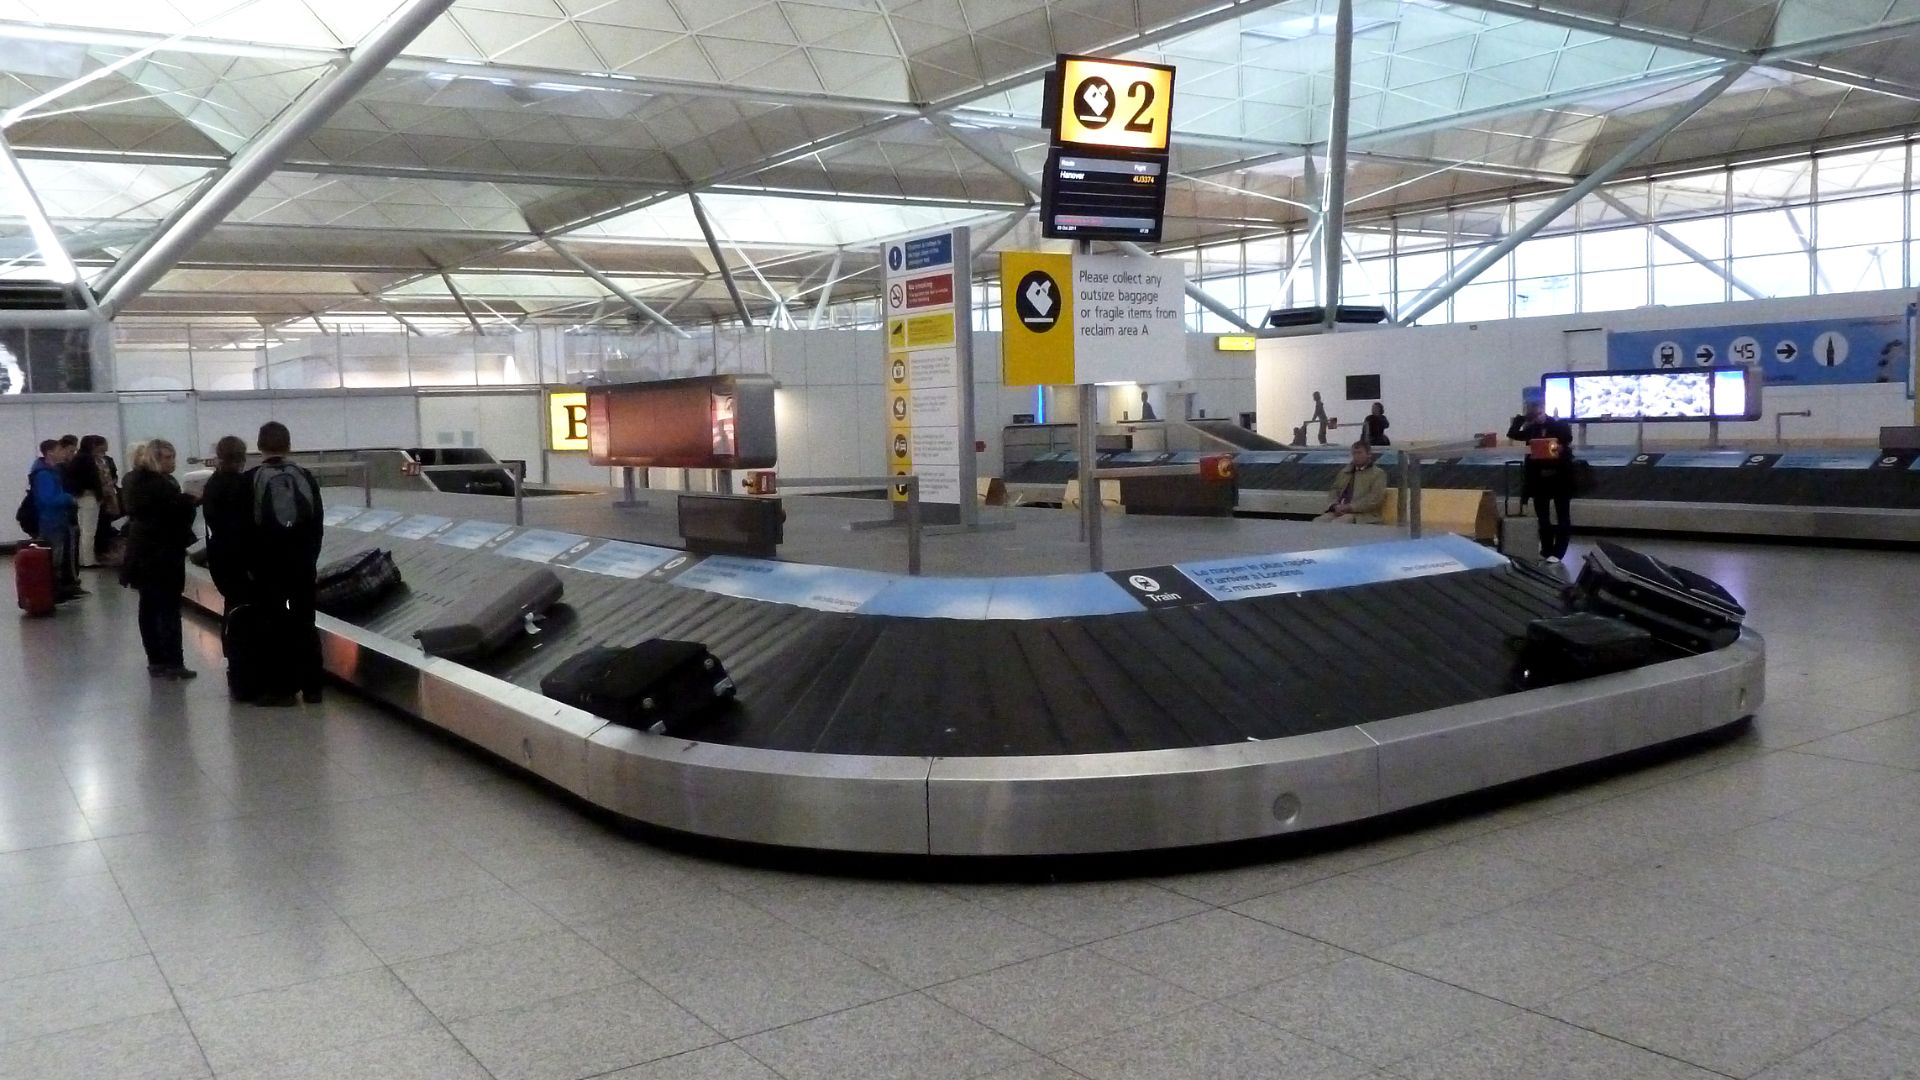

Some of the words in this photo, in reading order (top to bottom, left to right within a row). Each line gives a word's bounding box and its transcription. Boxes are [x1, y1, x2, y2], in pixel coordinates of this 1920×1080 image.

[1124, 81, 1155, 133] 2
[1060, 170, 1085, 180] Hanover
[1132, 175, 1155, 184] 4U3374
[1079, 270, 1109, 284] Please
[1112, 271, 1142, 285] collect
[1145, 275, 1162, 288] any
[1080, 287, 1115, 301] outsize
[1118, 288, 1159, 305] baggage
[1080, 308, 1091, 319] or
[1095, 305, 1125, 322] fragile
[1127, 306, 1153, 319] items
[1155, 306, 1178, 319] from
[1081, 323, 1115, 336] reclaim
[1117, 327, 1138, 336] area
[1141, 324, 1150, 336] A
[1734, 343, 1755, 360] 45
[563, 405, 588, 440] B
[1232, 581, 1278, 592] minutes
[1145, 592, 1182, 602] Train
